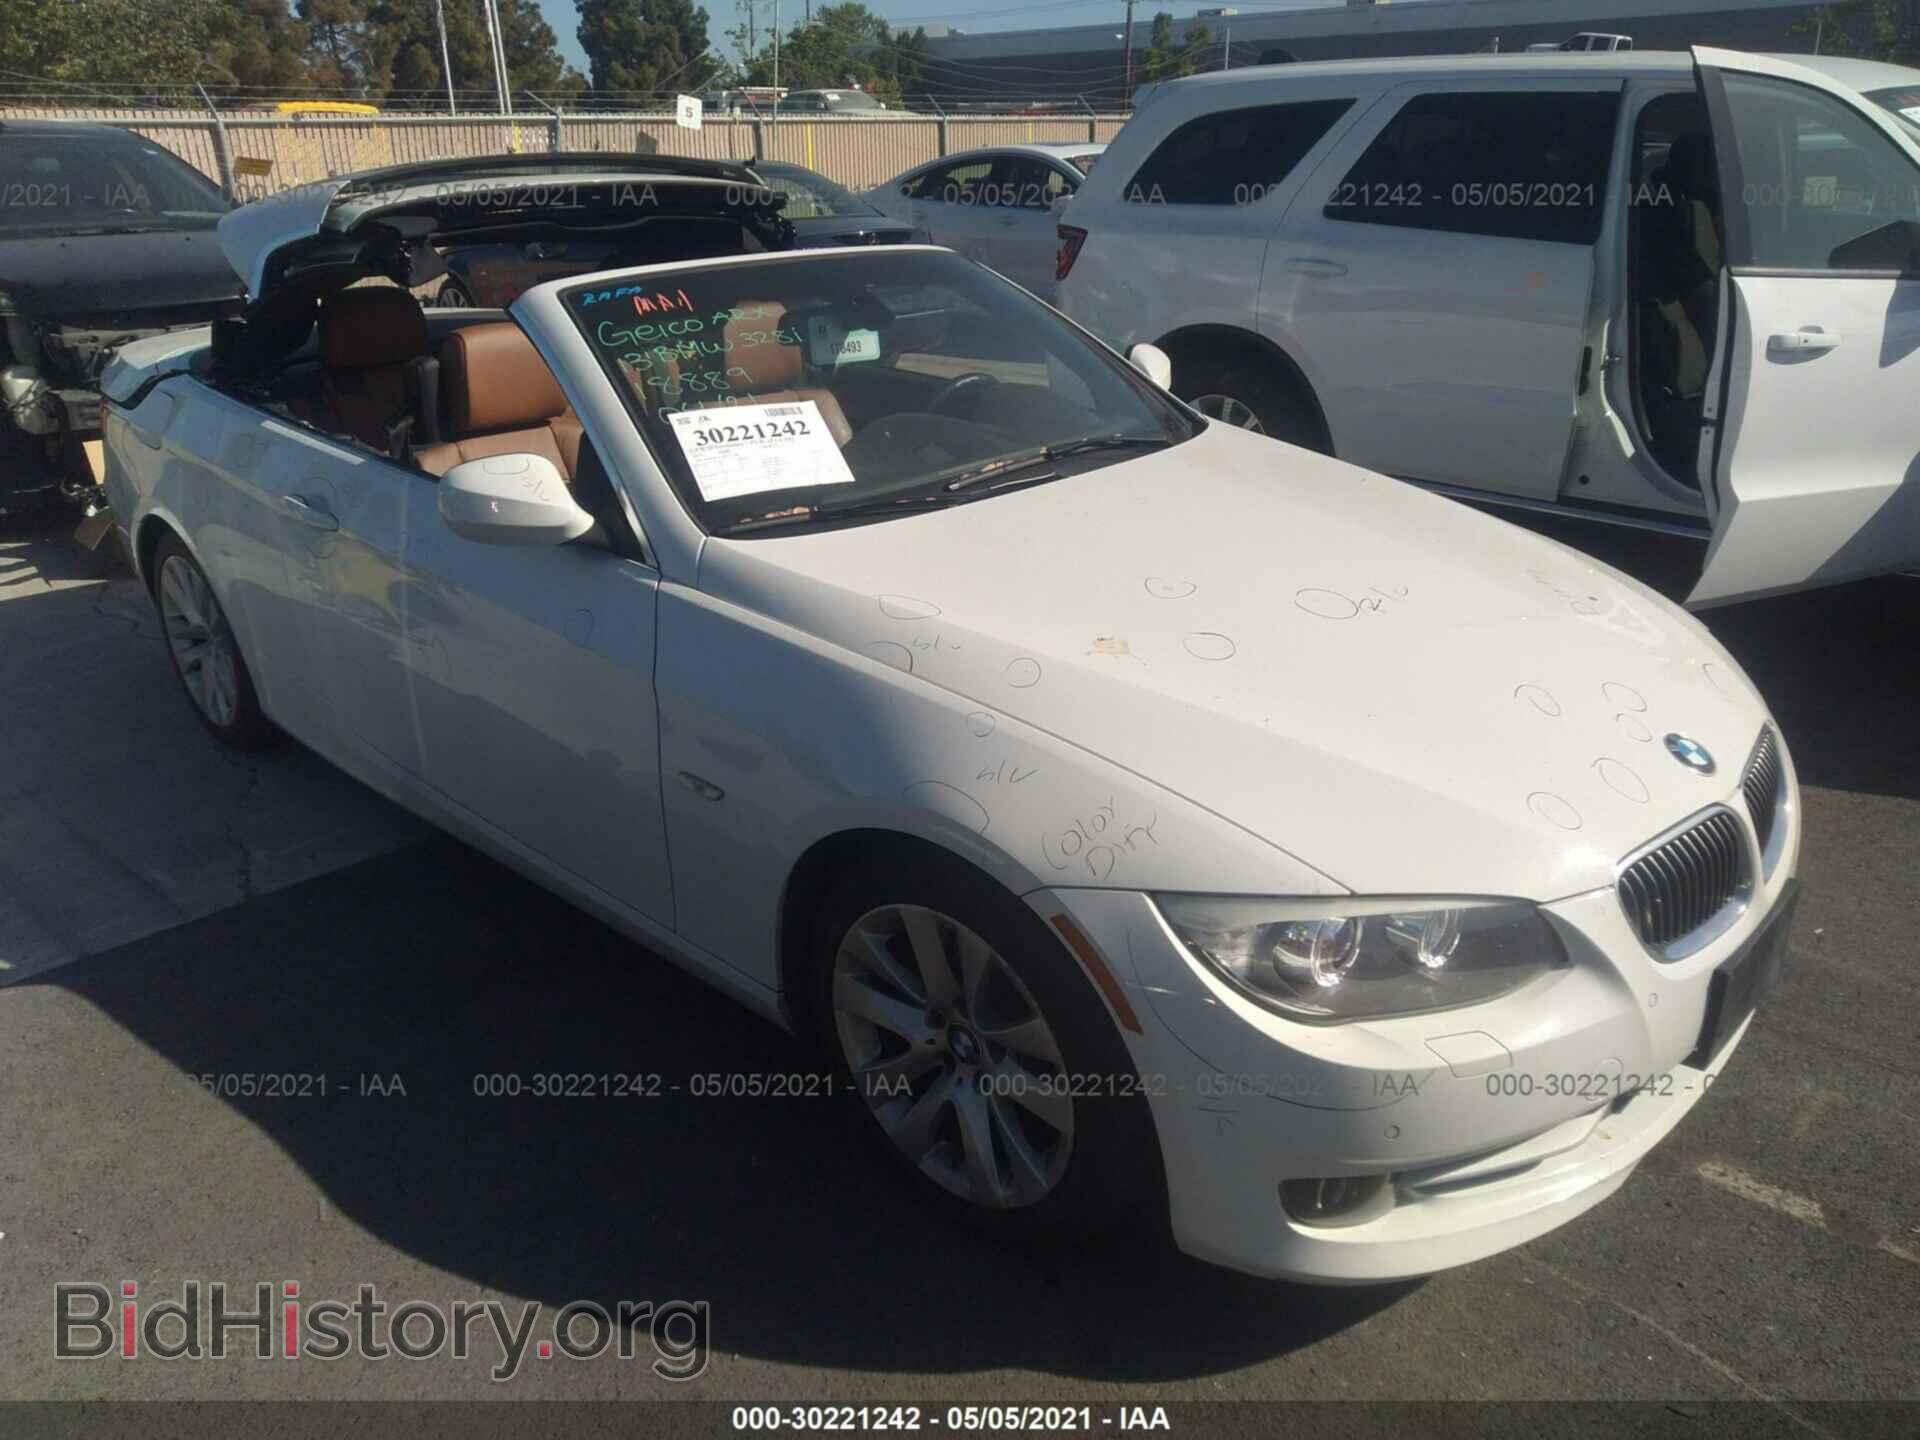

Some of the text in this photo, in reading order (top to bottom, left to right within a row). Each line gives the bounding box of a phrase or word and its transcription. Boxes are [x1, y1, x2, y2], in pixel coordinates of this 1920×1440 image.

[685, 106, 694, 118] 5
[647, 367, 753, 396] 8889
[694, 420, 811, 446] 30221242
